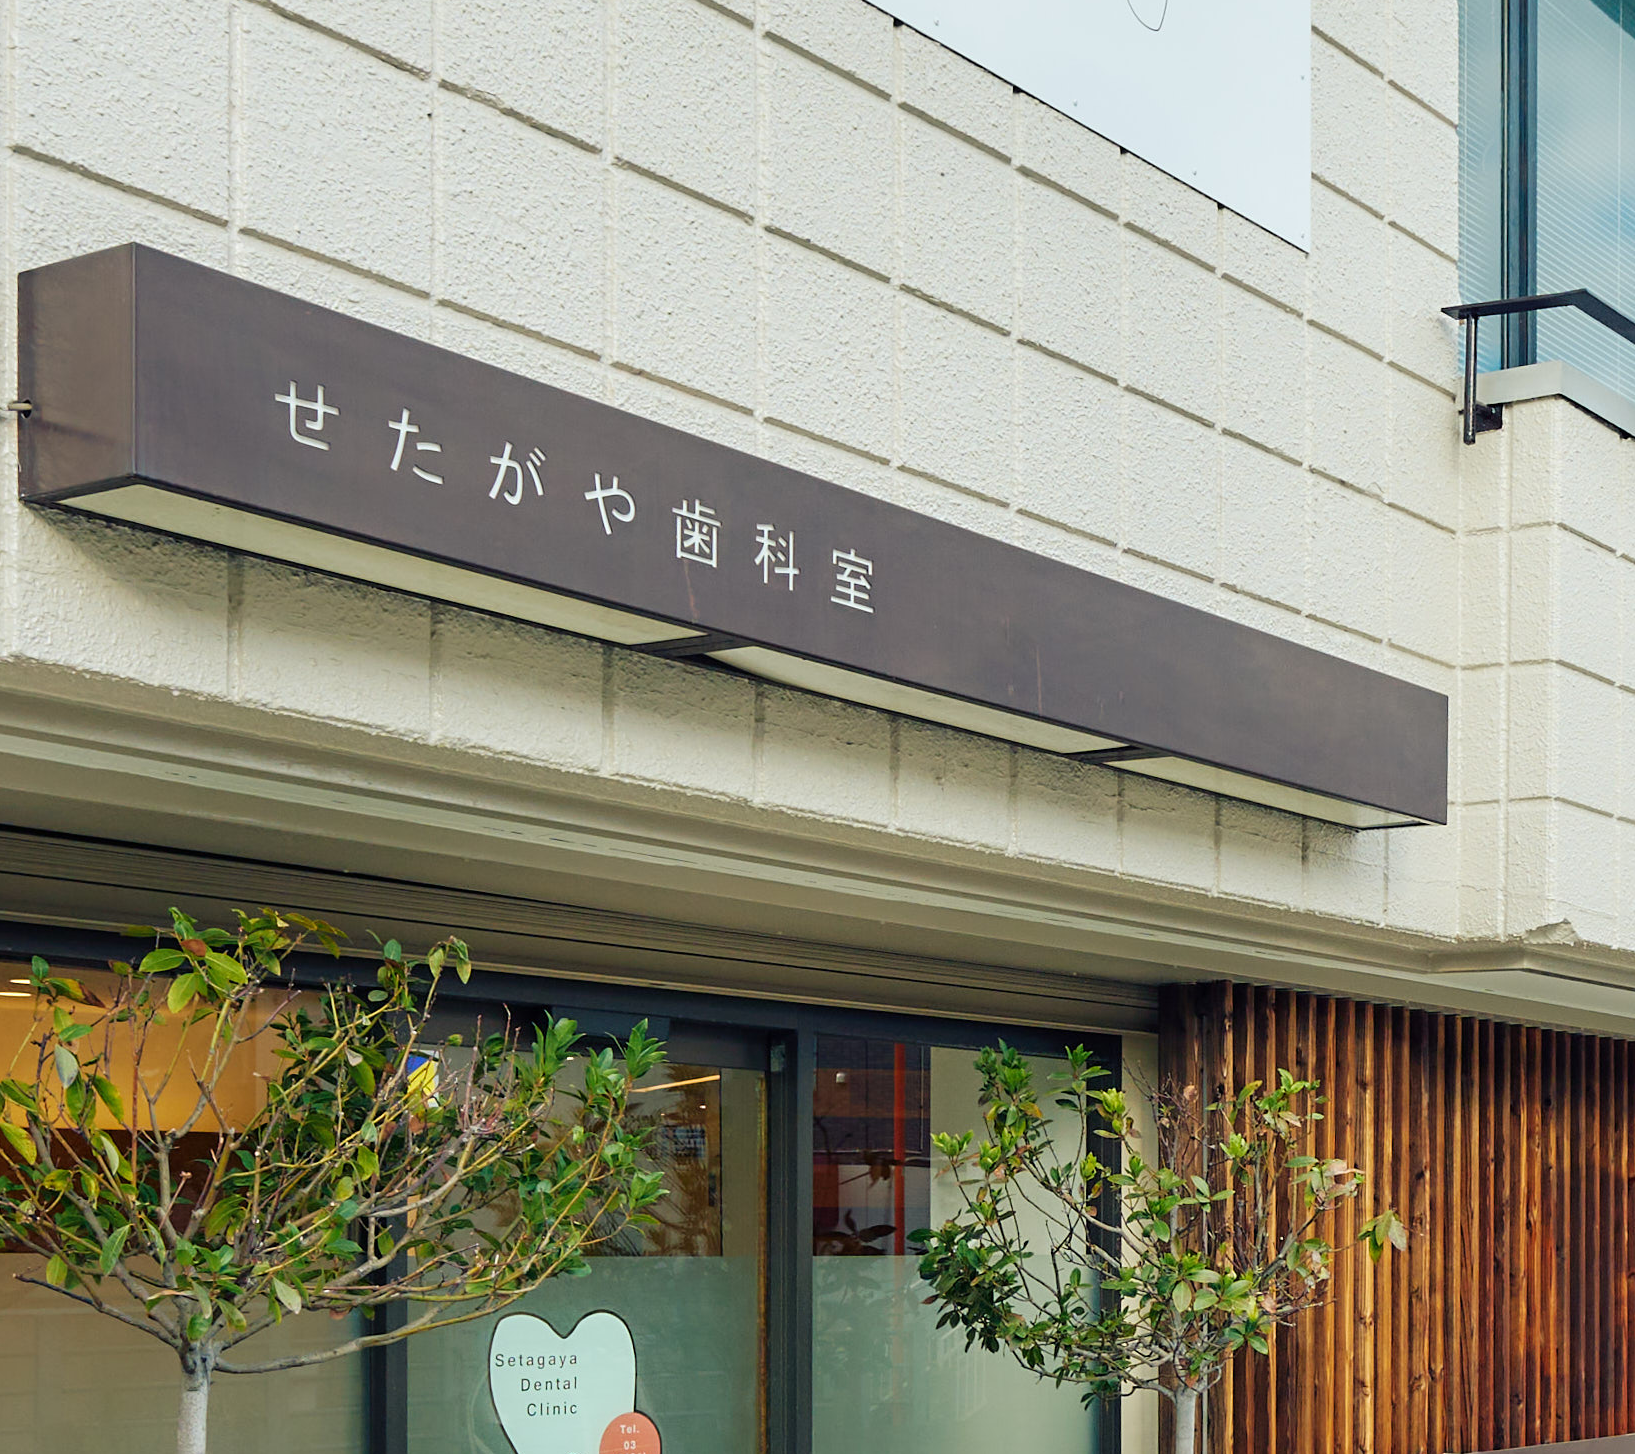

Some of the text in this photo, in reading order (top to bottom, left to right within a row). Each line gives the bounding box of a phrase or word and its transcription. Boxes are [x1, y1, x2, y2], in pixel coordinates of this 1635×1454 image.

[273, 379, 876, 615] せたがや歯科室
[494, 1352, 579, 1370] Setagaya
[520, 1376, 579, 1392] Dental
[526, 1400, 579, 1417] Clinic
[619, 1423, 640, 1435] Tel.
[623, 1439, 638, 1451] 03
